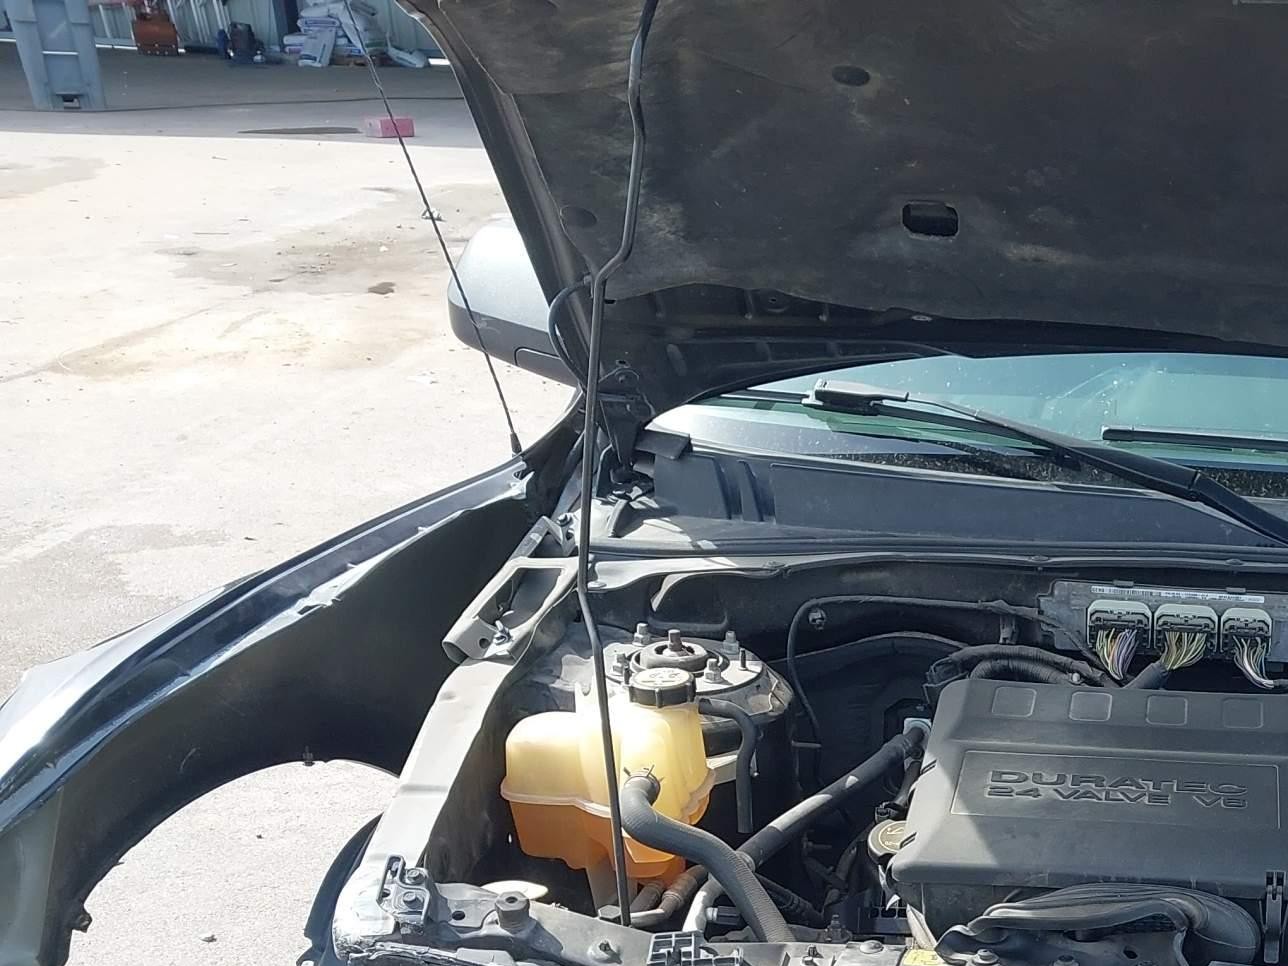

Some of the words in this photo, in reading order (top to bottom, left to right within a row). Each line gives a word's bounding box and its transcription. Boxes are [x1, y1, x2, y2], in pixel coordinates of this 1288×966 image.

[990, 769, 1248, 796] DURATEC
[987, 785, 1042, 798] 24
[1053, 788, 1171, 806] VALVE
[1192, 794, 1248, 809] V6
